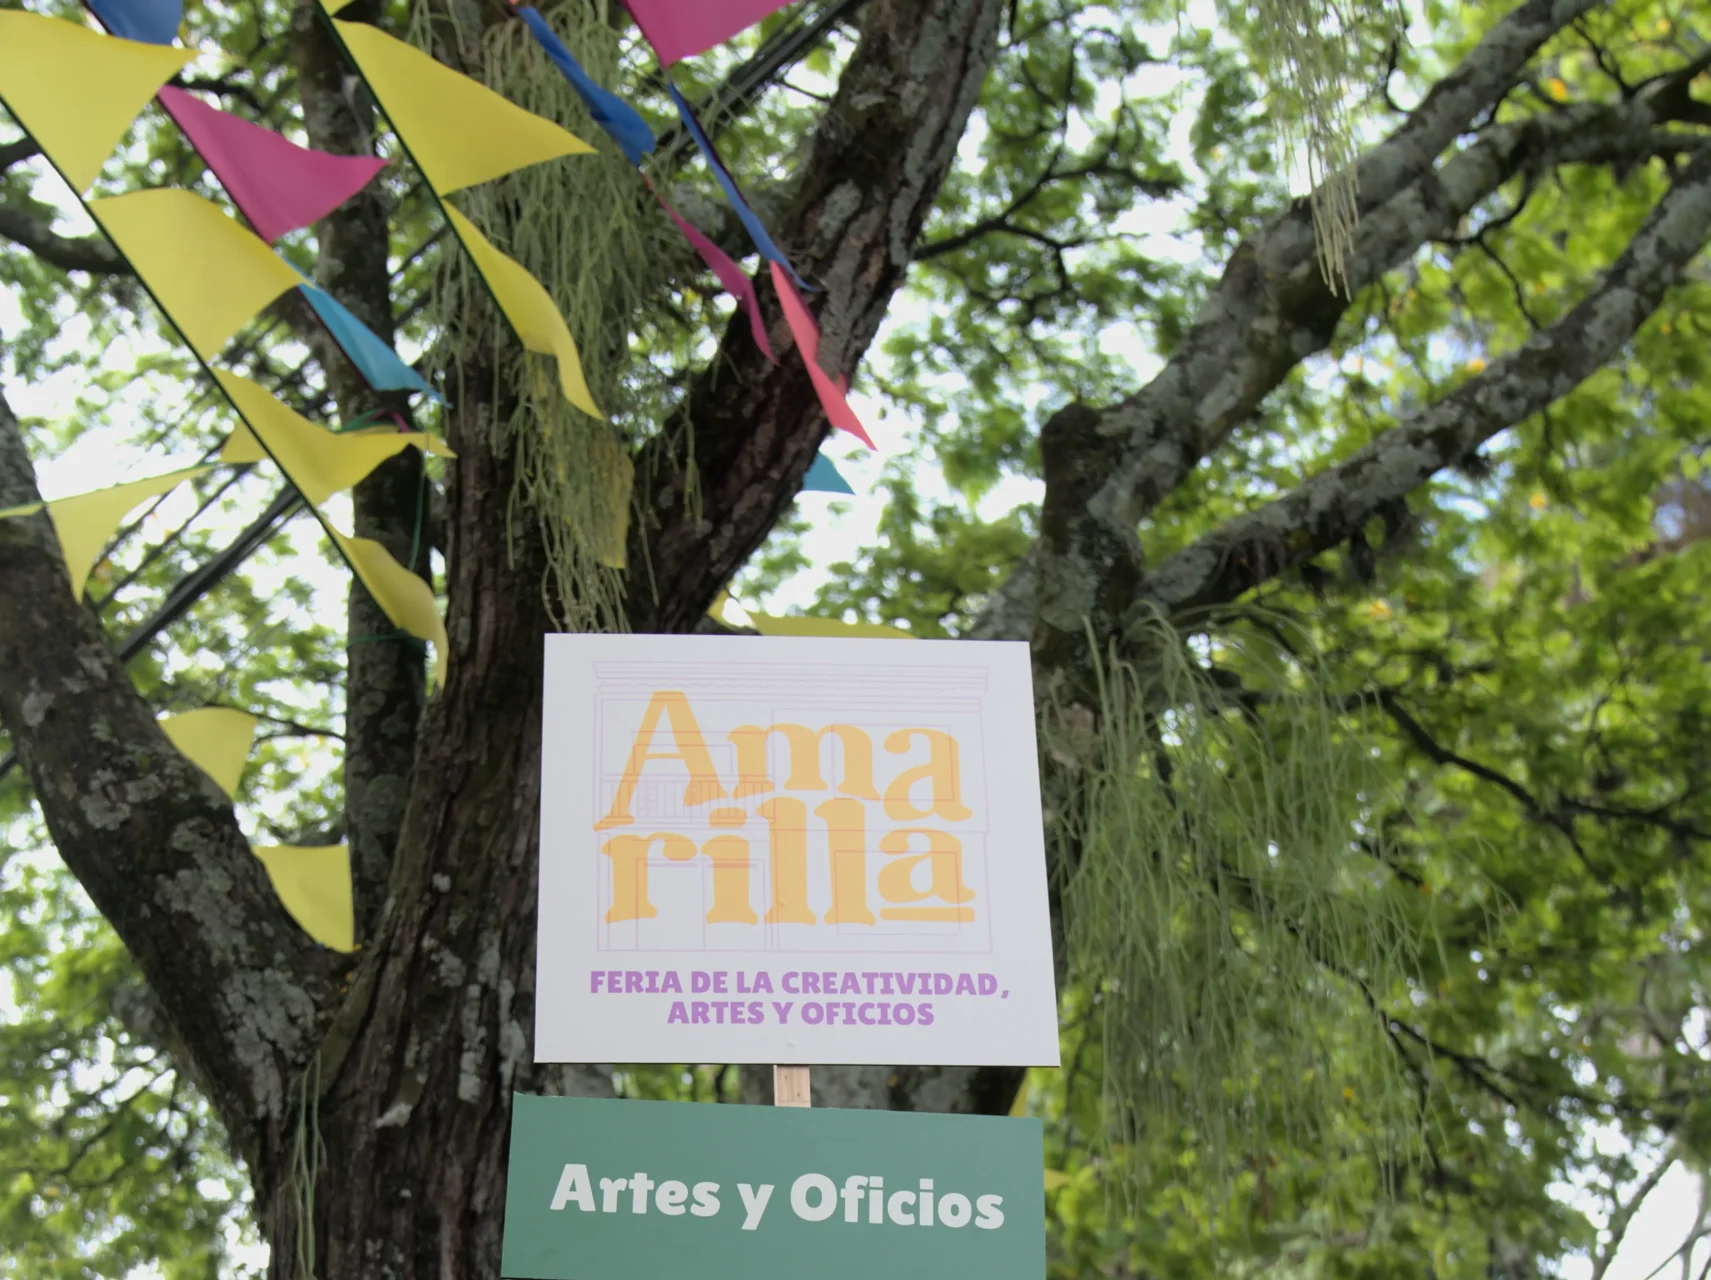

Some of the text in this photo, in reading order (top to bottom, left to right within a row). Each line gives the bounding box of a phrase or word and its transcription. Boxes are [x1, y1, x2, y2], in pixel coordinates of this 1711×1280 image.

[593, 691, 973, 833] Ama
[601, 797, 976, 926] rilla
[590, 970, 1009, 999] FERIA DE LA CREATIVIDAD,
[667, 1001, 935, 1026] ARTES Y OFICIOS
[549, 1163, 1005, 1231] Artes y Oficios
